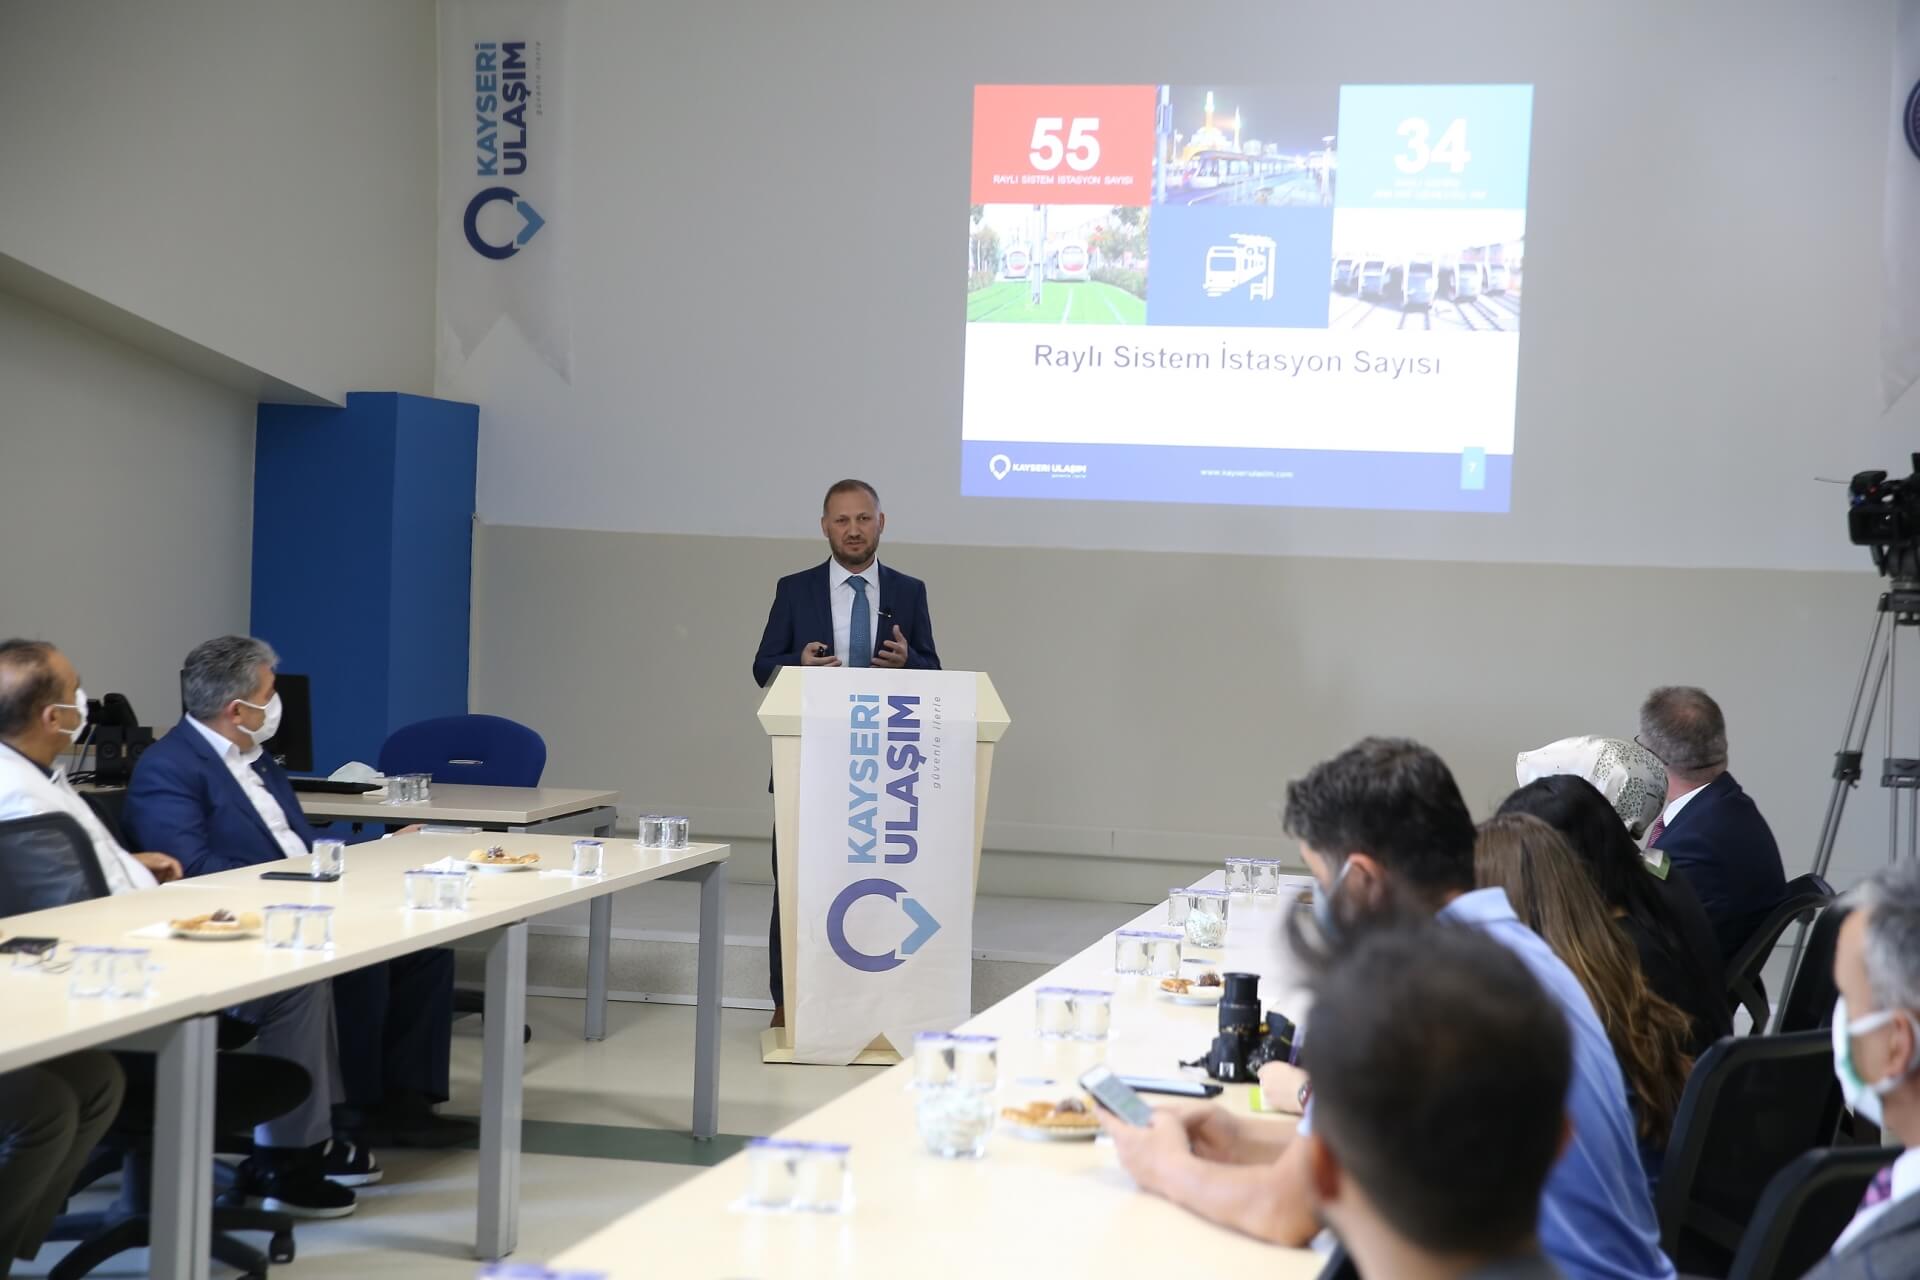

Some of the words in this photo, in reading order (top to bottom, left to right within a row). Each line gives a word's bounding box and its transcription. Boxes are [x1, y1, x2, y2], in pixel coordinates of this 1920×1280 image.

[502, 42, 531, 175] ULAŞIM
[1028, 117, 1101, 171] 55
[1394, 118, 1471, 173] 34
[992, 175, 1019, 185] RAYLI
[1034, 344, 1102, 373] Raylı
[1113, 346, 1210, 369] Sistem
[1221, 341, 1342, 377] İstasyon
[1354, 350, 1441, 379] Sayısı
[884, 695, 927, 864] ULAŞIM
